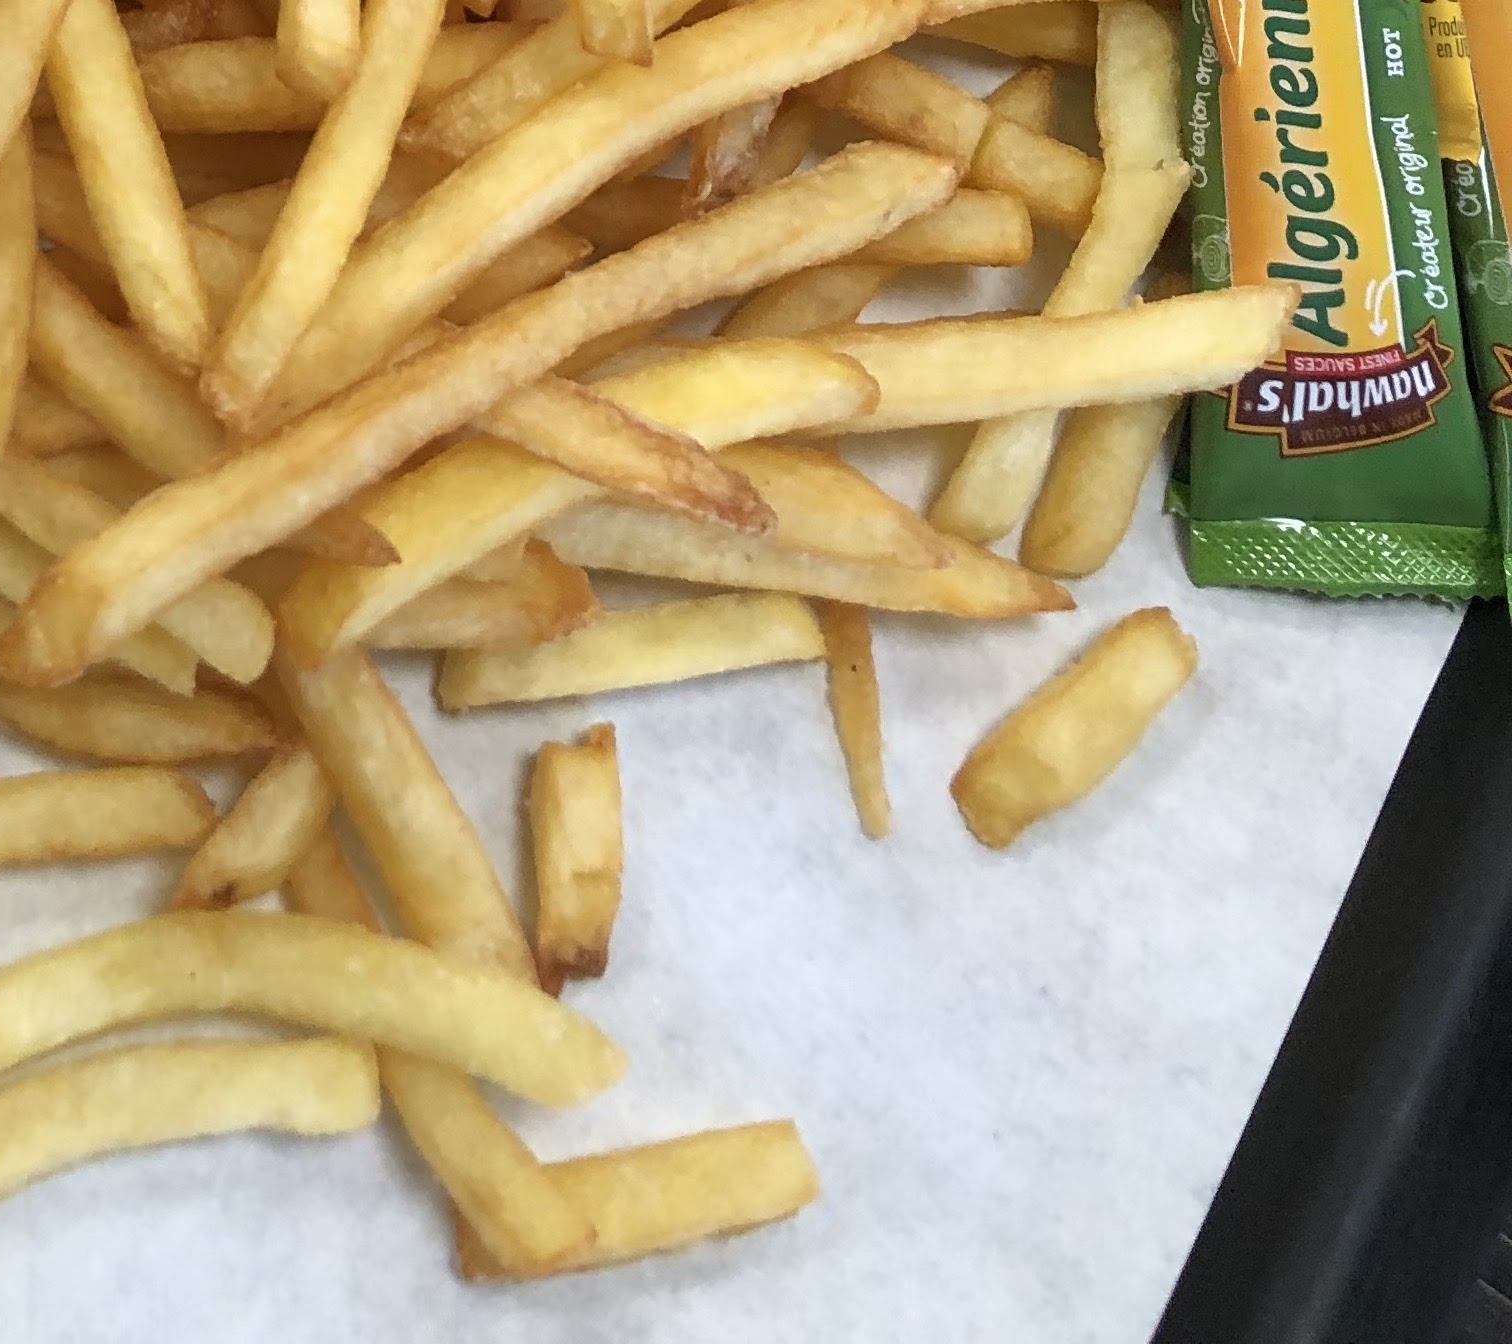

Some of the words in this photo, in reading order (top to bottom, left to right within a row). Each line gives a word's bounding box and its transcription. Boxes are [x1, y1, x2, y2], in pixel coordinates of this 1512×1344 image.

[1382, 28, 1405, 78] HOT
[1293, 355, 1356, 372] SAUCES
[1357, 346, 1402, 371] FINEST
[1257, 359, 1436, 425] nawhal's
